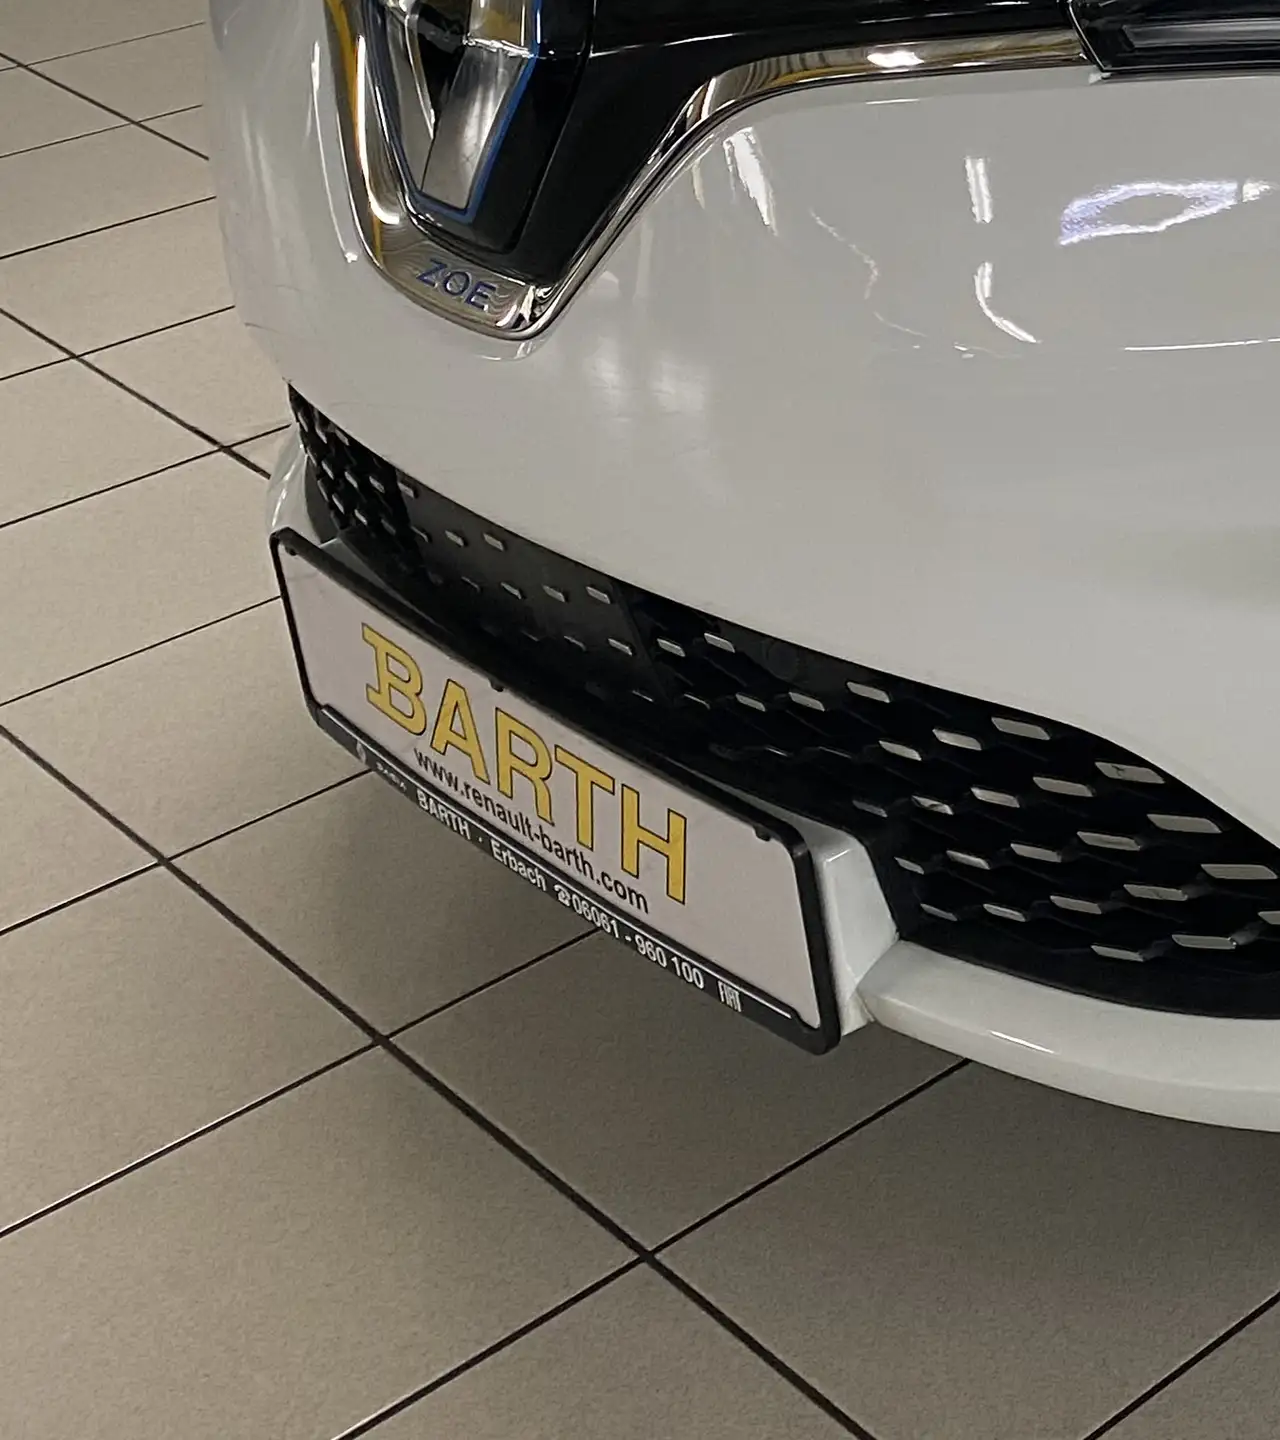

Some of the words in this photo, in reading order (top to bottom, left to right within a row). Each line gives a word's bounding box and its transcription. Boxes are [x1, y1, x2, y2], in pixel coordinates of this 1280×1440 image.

[416, 257, 497, 311] ZOE
[361, 622, 687, 905] BARTH
[413, 747, 650, 914] www.renault-barth.com
[416, 787, 471, 841] BARTH
[490, 838, 547, 892] Erbach
[571, 894, 620, 939] 06061
[634, 933, 668, 968] 960
[671, 956, 705, 990] 100
